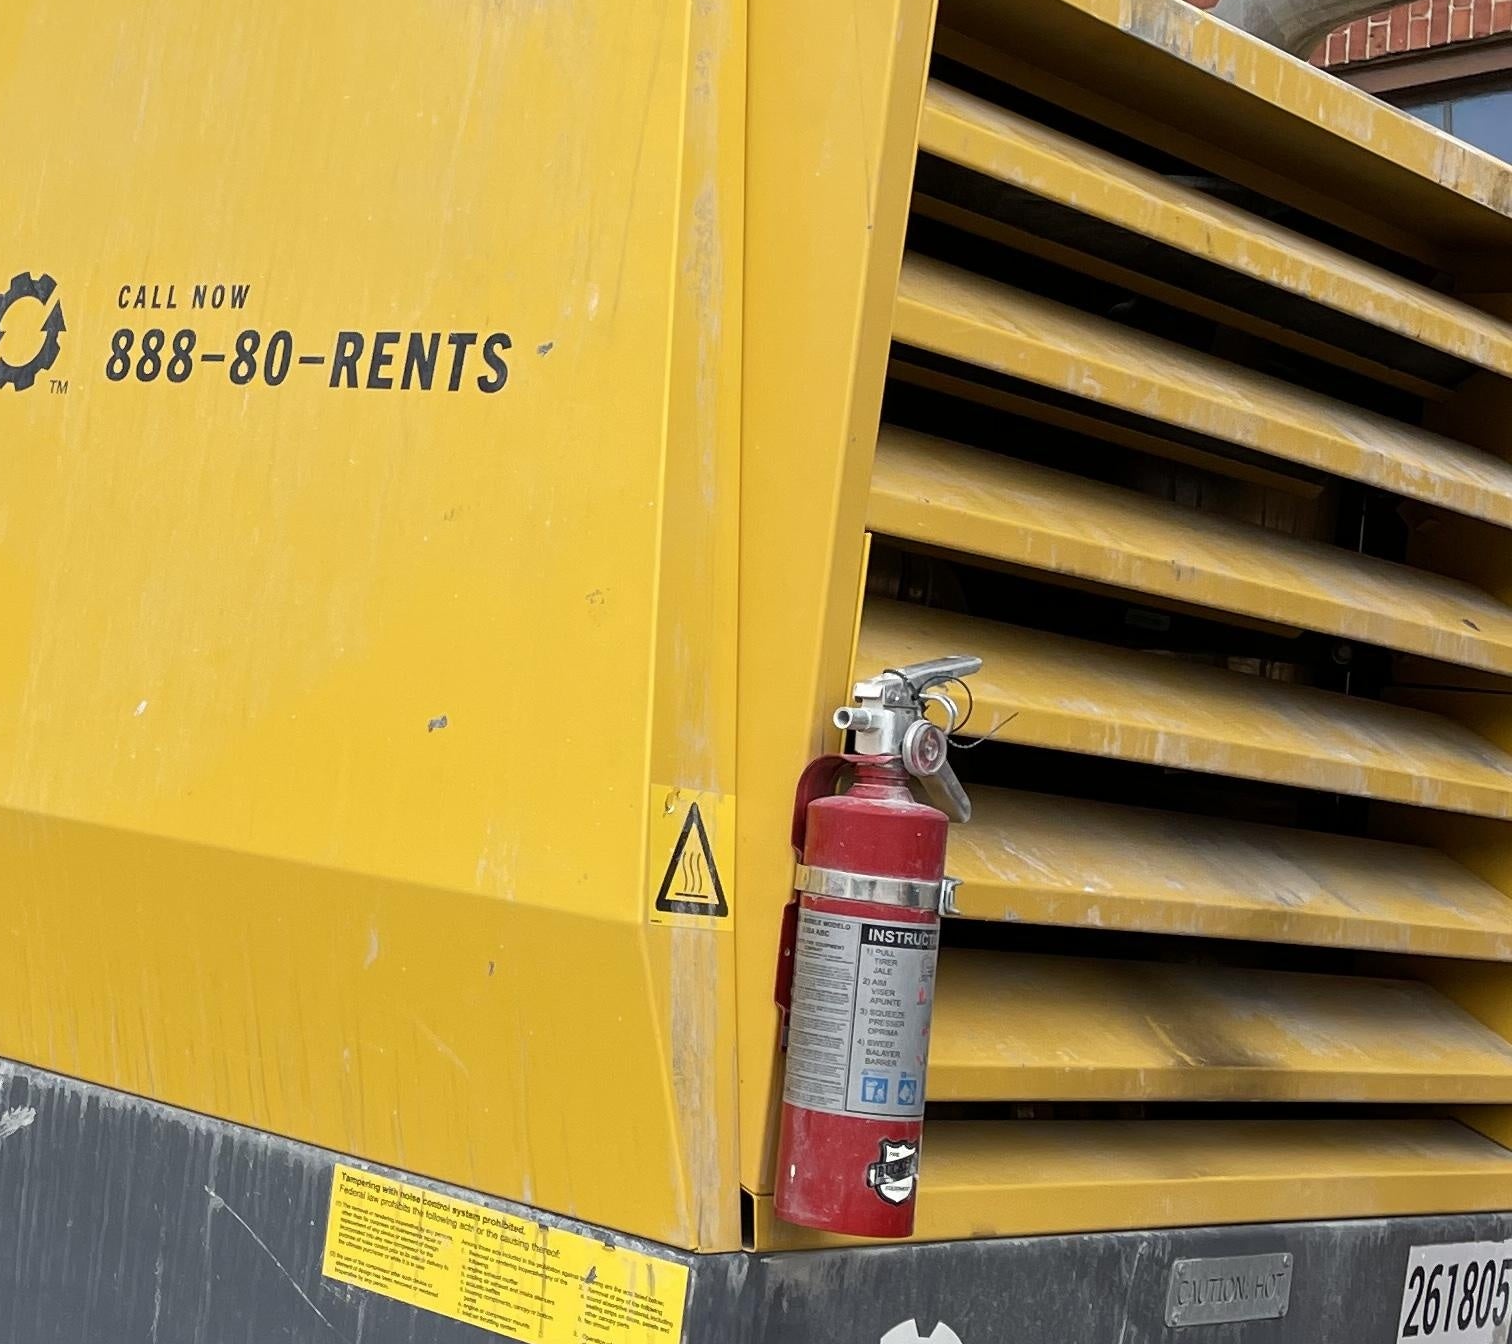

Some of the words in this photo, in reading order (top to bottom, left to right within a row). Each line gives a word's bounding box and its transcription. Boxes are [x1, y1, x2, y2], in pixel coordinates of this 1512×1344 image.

[118, 285, 178, 309] CALL
[192, 284, 251, 309] NOW
[105, 327, 512, 394] 888-80-RENTS
[1402, 1258, 1512, 1338] 261805
